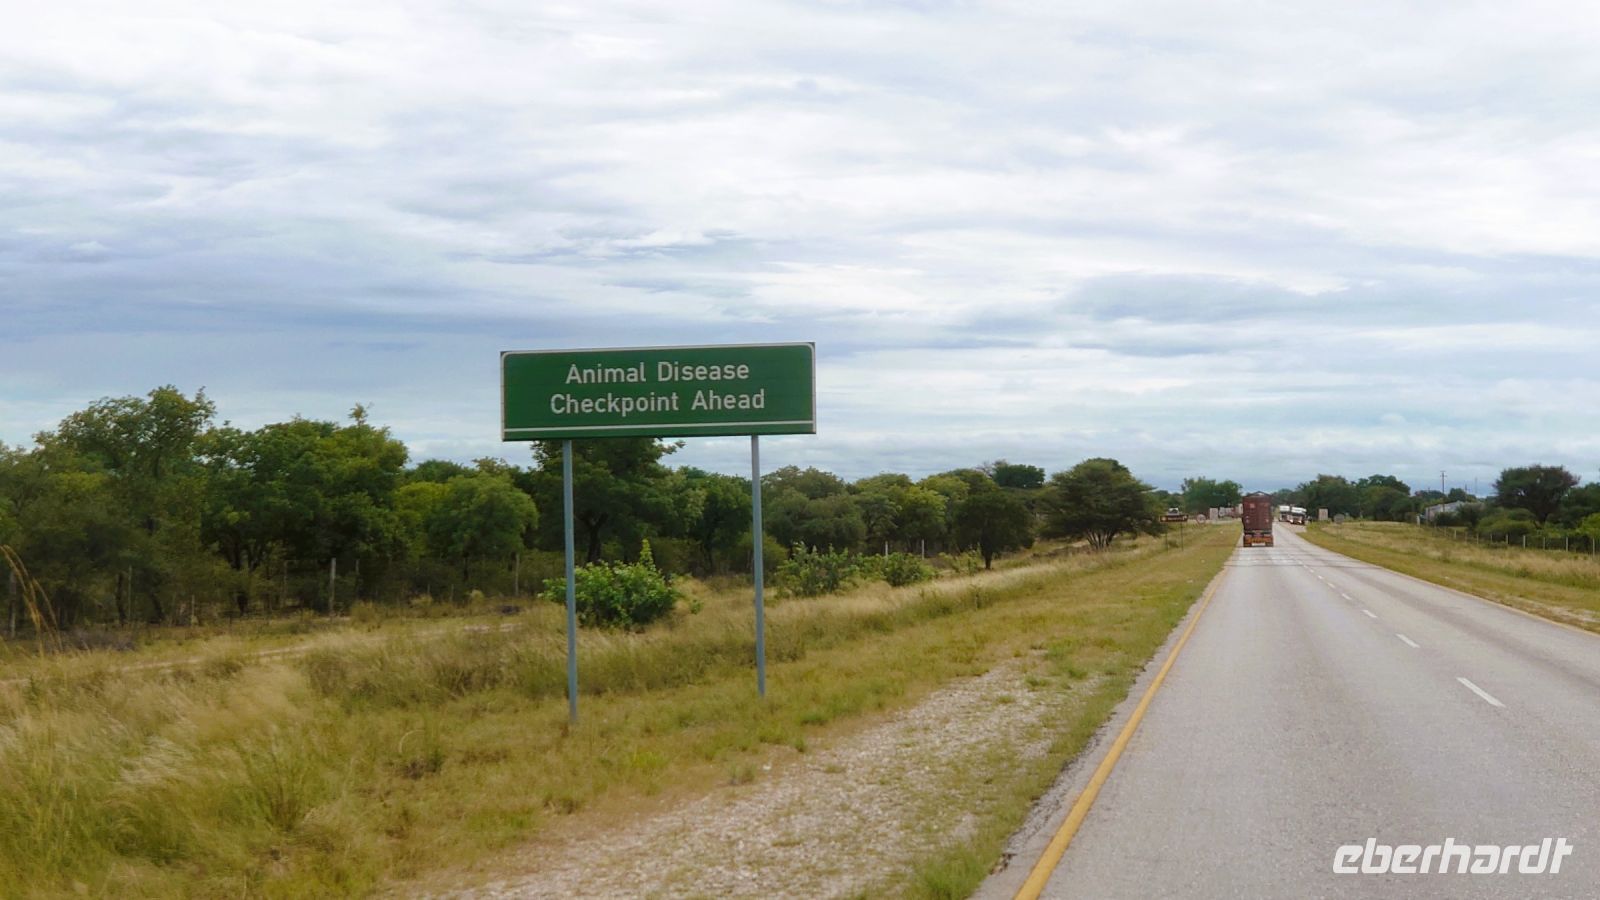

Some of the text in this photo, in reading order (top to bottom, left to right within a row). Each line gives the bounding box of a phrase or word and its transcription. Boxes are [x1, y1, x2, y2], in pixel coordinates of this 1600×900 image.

[565, 361, 749, 384] Animal Disease
[550, 389, 765, 417] Checkpoint Ahead
